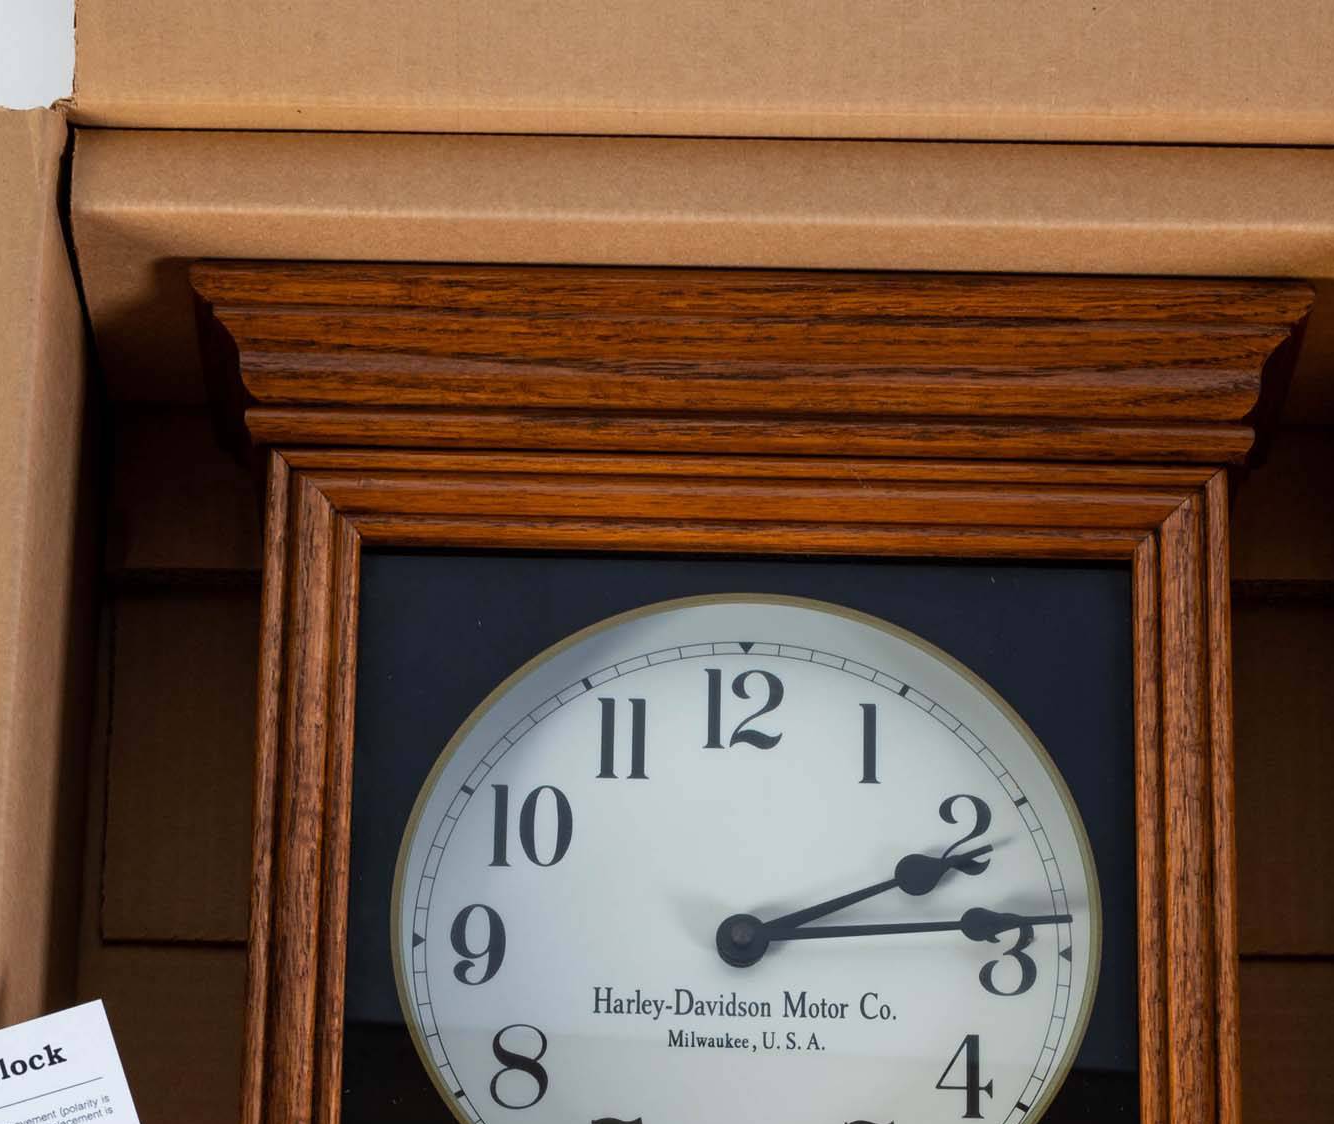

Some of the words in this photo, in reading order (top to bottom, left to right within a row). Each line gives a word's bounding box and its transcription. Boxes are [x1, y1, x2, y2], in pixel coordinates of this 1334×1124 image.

[595, 697, 650, 780] 11
[702, 668, 786, 750] 12
[858, 703, 881, 784] 1
[488, 783, 574, 868] 10
[938, 793, 992, 876] 2
[449, 903, 507, 986] 9
[978, 912, 1038, 997] 3
[592, 986, 772, 1020] Harley-Davidson
[782, 991, 849, 1019] Motor
[859, 992, 897, 1021] Co.
[667, 1029, 758, 1052] Milwaukee,
[59, 1099, 98, 1118] (polarity
[101, 1095, 110, 1103] is
[489, 1023, 549, 1111] 8
[935, 1033, 994, 1120] 4
[104, 1106, 113, 1114] is
